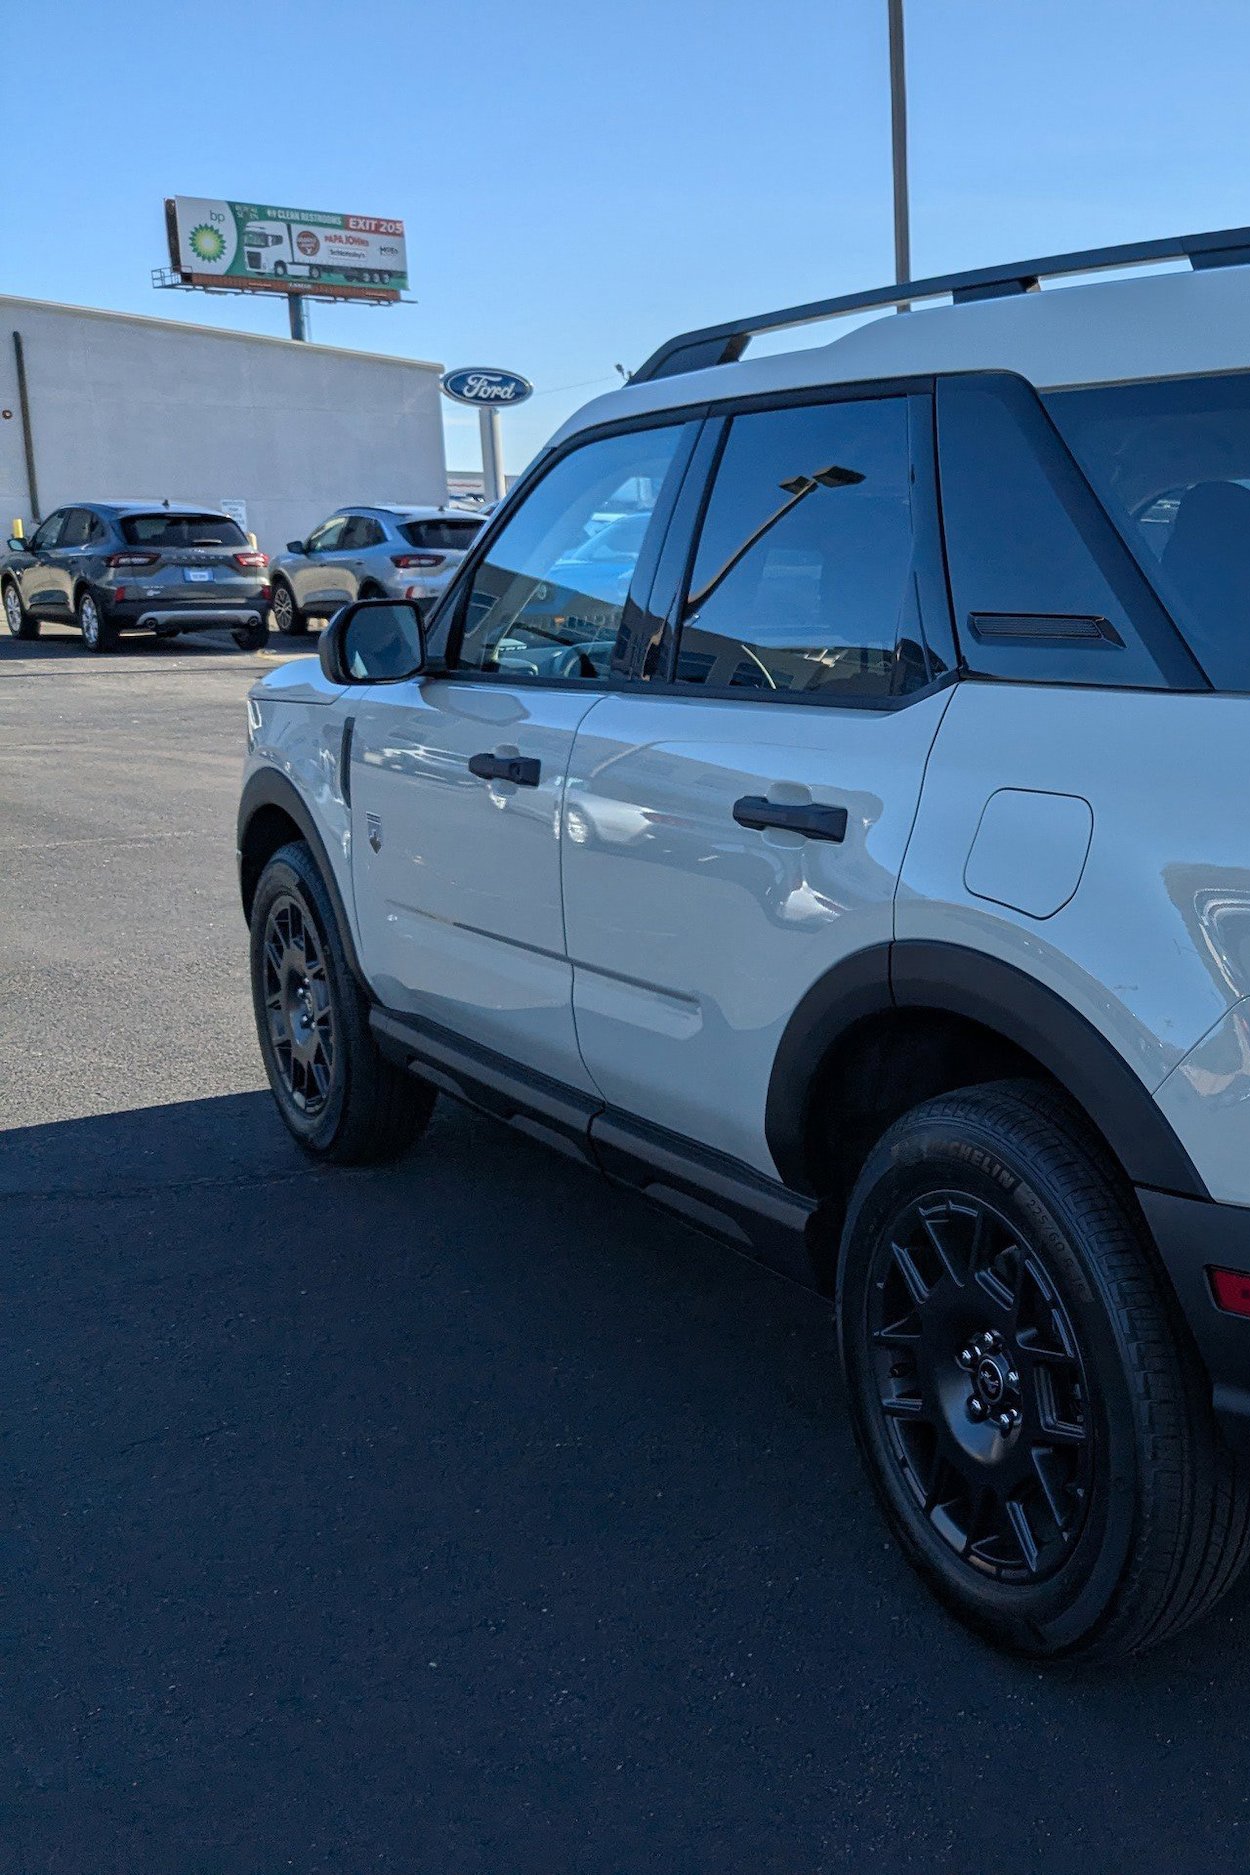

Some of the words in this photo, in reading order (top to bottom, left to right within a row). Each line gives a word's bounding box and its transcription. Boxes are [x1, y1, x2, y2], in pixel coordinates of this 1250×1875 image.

[209, 209, 225, 225] bp
[349, 217, 377, 231] EXIT
[379, 222, 403, 234] 205
[462, 373, 516, 400] Ford
